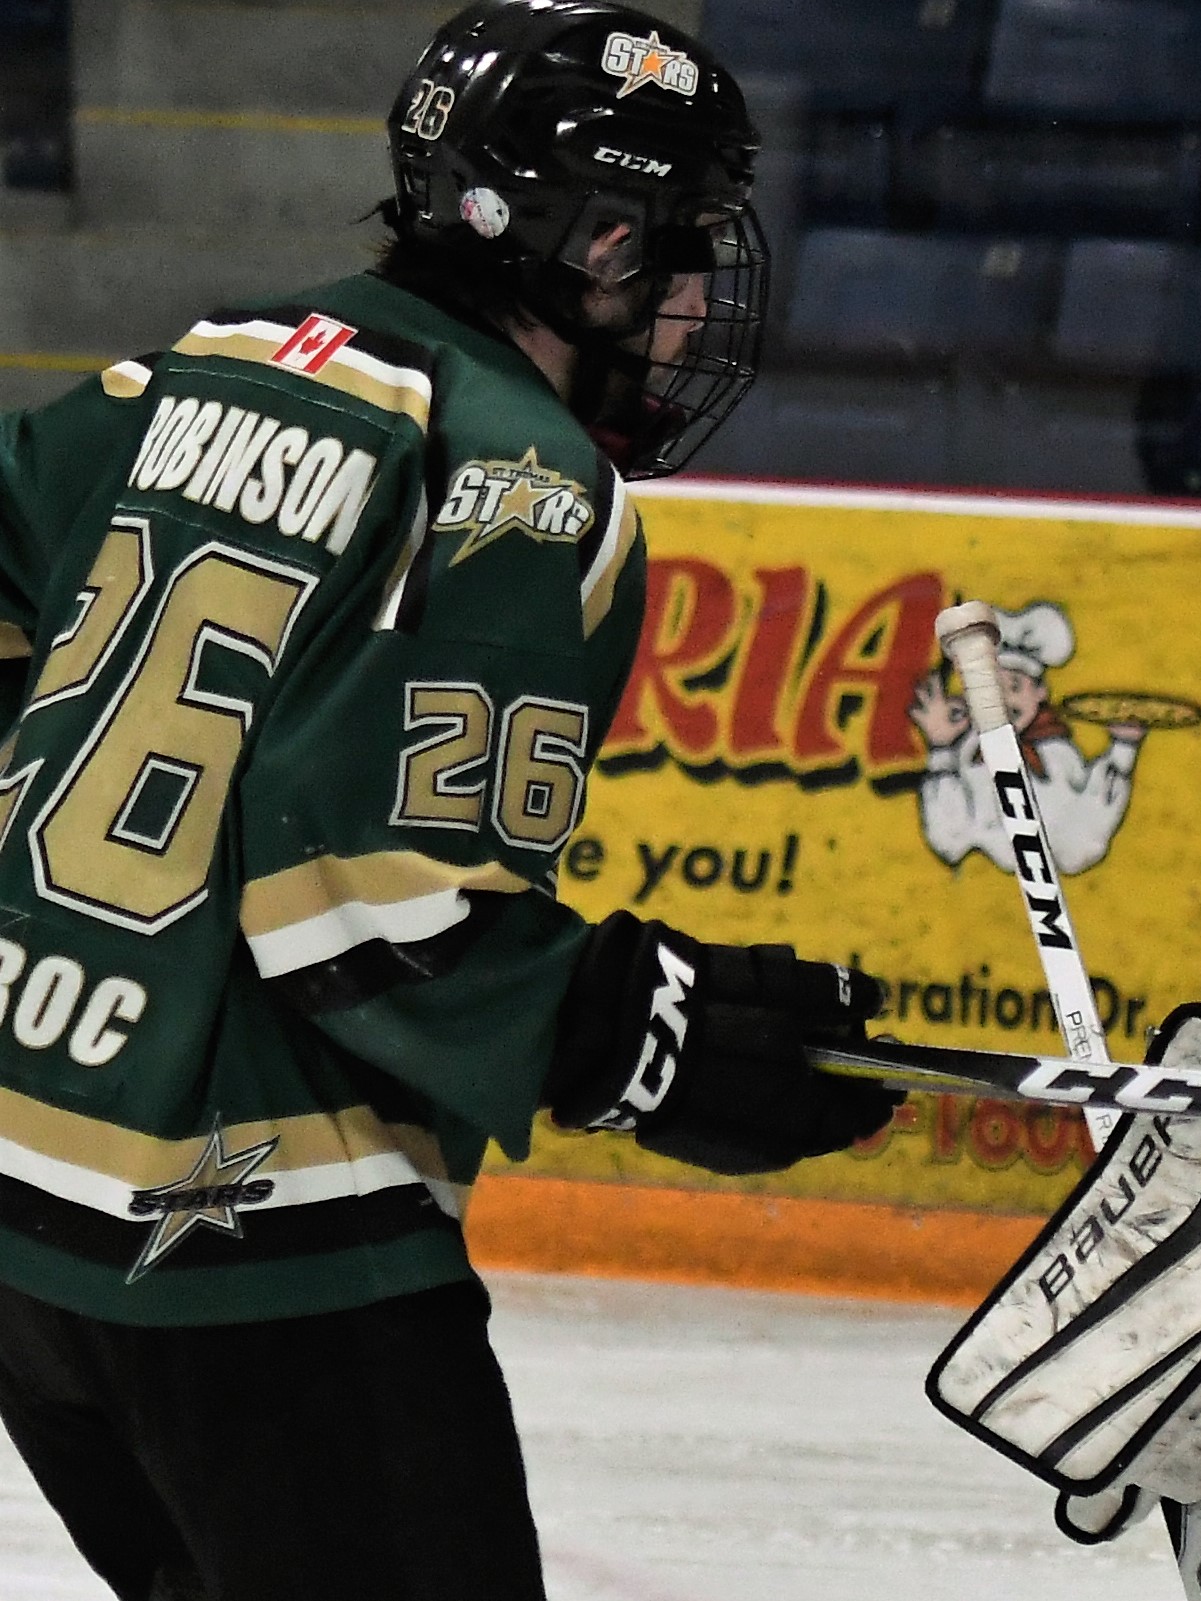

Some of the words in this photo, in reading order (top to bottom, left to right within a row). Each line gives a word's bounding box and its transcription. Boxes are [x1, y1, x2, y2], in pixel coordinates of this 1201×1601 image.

[401, 79, 455, 141] 26
[593, 146, 673, 178] CCM
[127, 396, 377, 557] ROBINSON
[604, 556, 948, 768] RIA
[388, 680, 589, 852] 26
[633, 833, 799, 904] you!
[994, 769, 1073, 950] CCM
